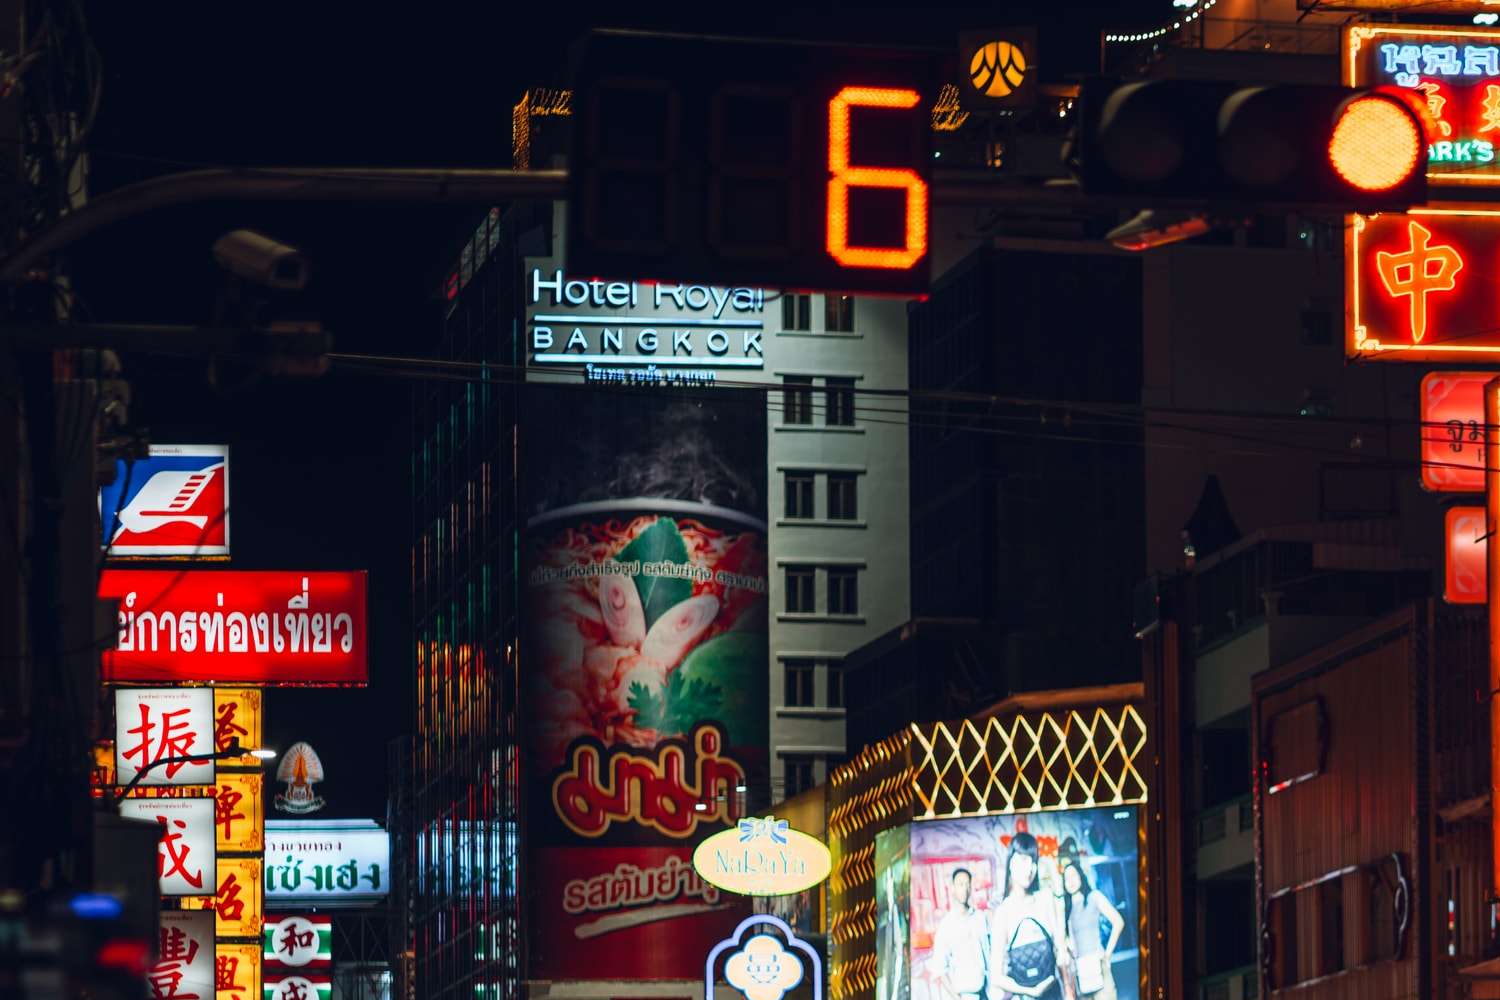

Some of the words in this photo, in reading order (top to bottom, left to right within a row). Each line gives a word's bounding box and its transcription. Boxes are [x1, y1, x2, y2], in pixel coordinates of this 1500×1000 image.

[826, 86, 928, 270] 6
[532, 269, 637, 307] Hotel
[655, 283, 763, 319] Royal
[533, 326, 763, 354] BANGKOK
[118, 577, 353, 653] ย์การท่องเที่ยว
